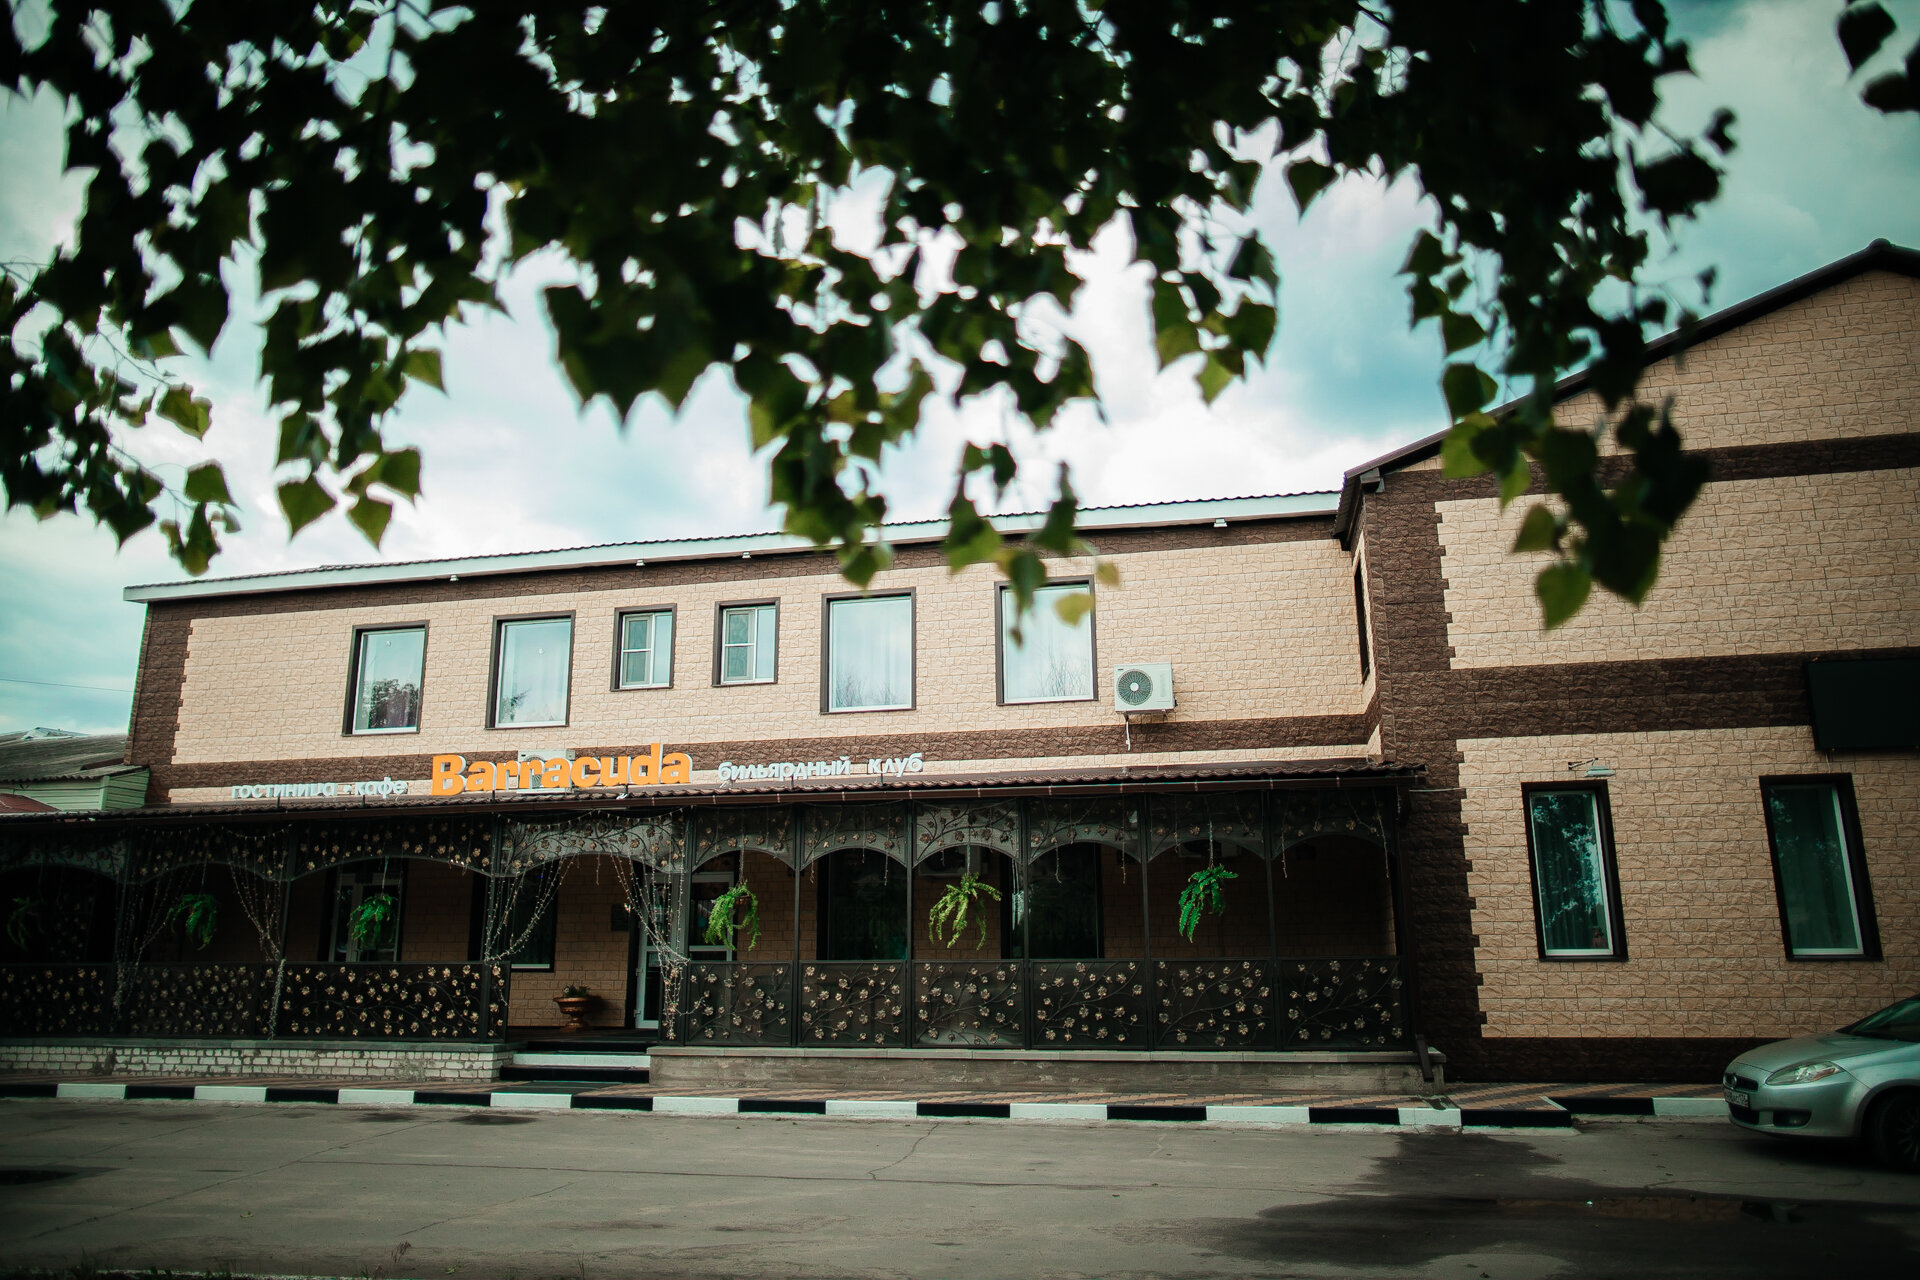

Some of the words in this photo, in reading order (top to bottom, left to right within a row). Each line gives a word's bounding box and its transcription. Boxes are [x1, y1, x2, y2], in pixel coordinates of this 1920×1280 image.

[432, 743, 692, 796] Barracuda
[718, 756, 850, 781] бильярдный
[868, 753, 923, 777] клуб
[232, 784, 338, 798] гостиница
[355, 777, 408, 799] кафе
